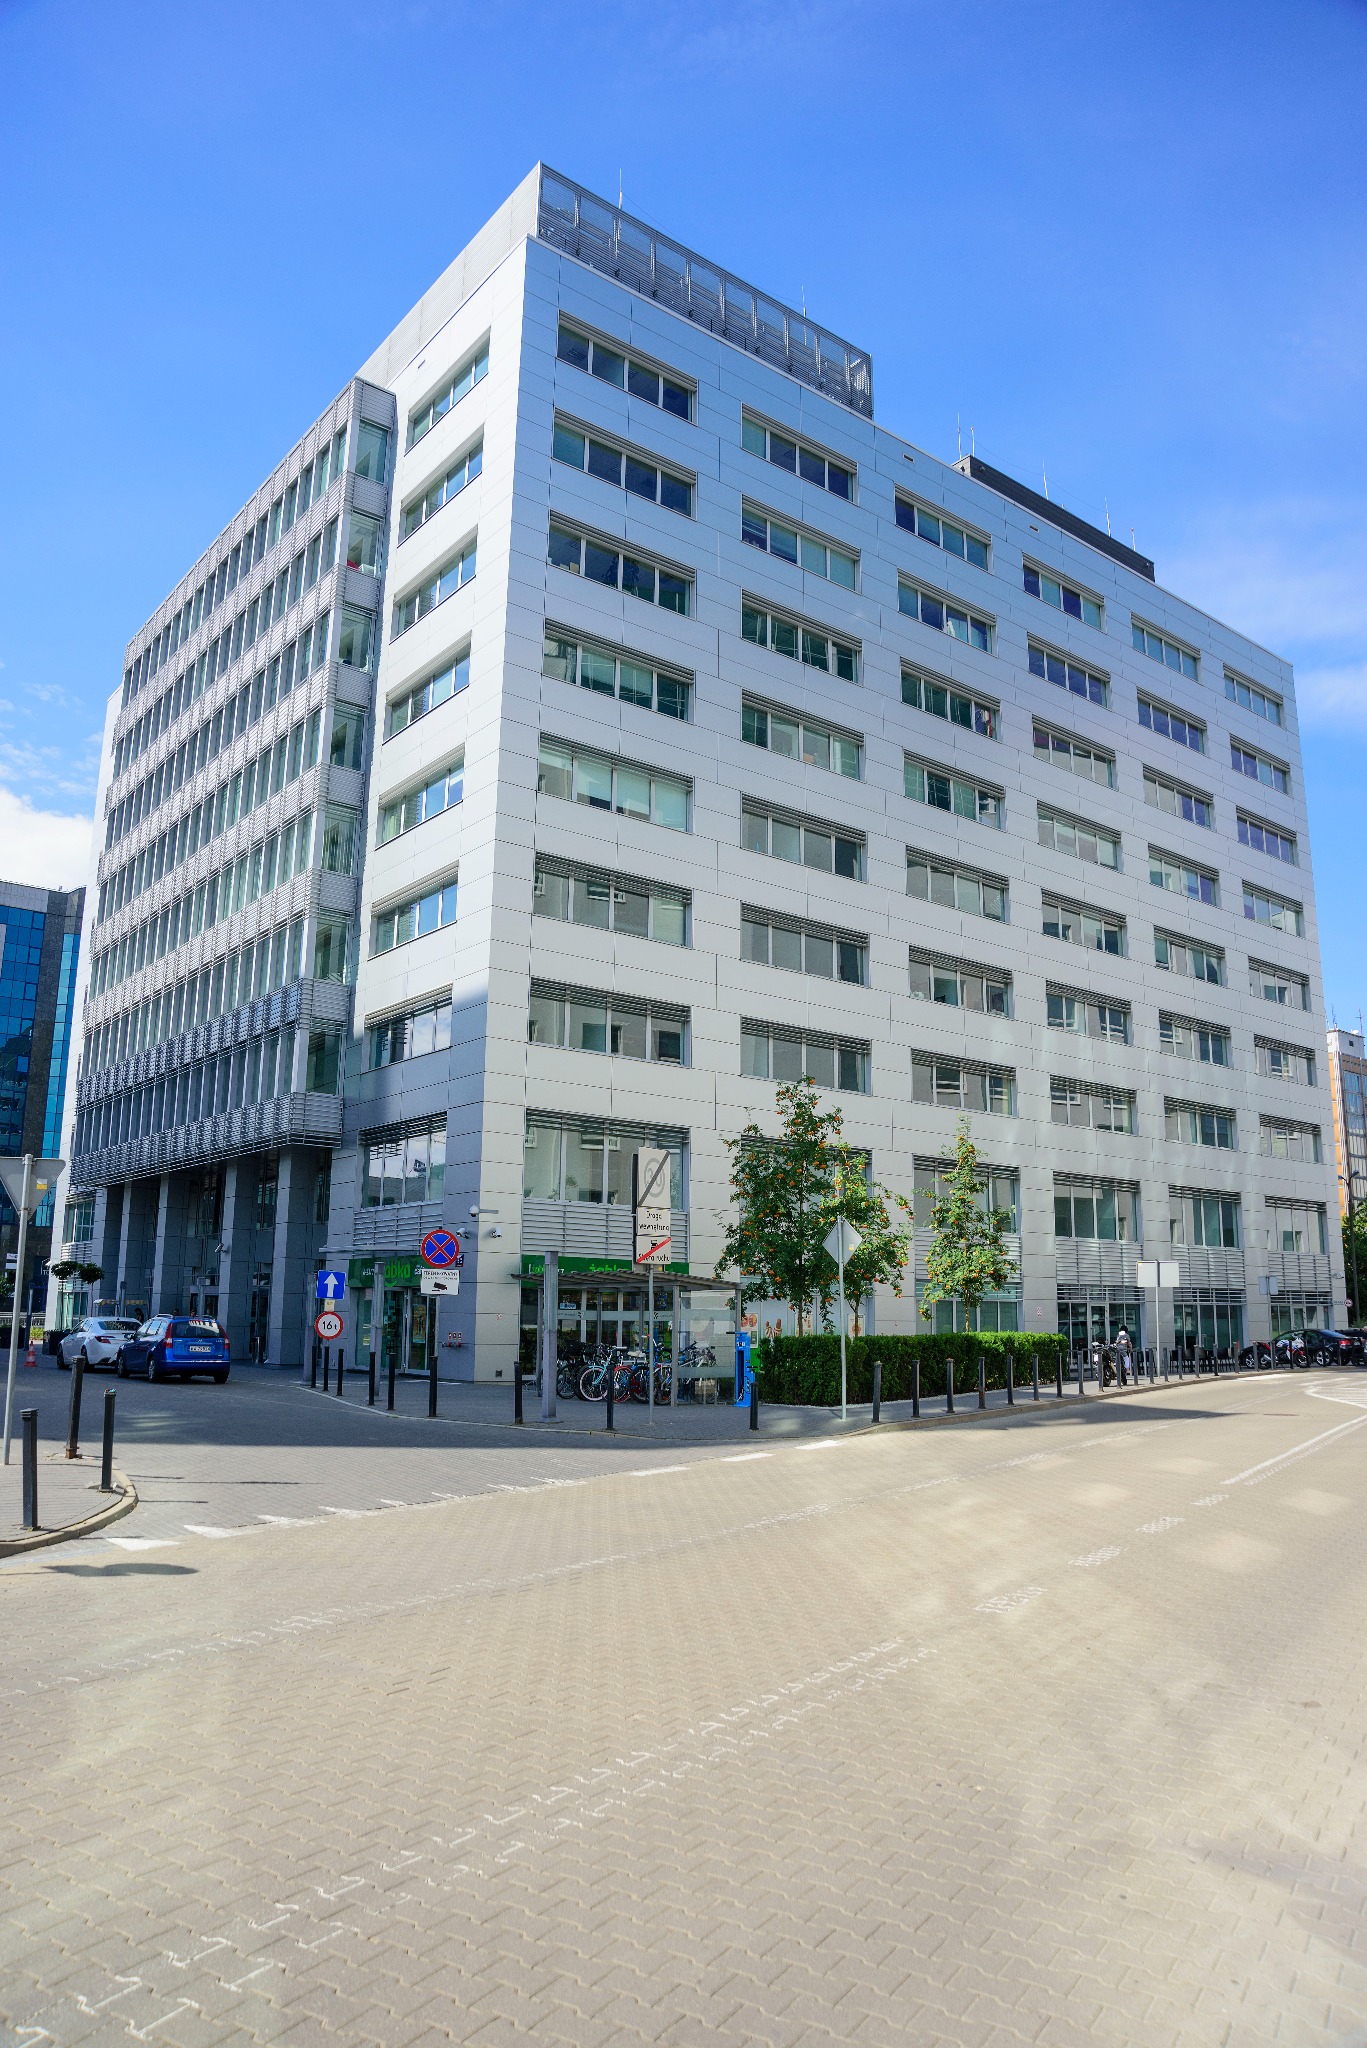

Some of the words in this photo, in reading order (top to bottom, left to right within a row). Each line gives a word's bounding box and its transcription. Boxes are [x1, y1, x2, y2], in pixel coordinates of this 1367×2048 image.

[646, 1210, 662, 1221] Droga
[384, 1260, 411, 1279] abka
[322, 1320, 333, 1330] 16
